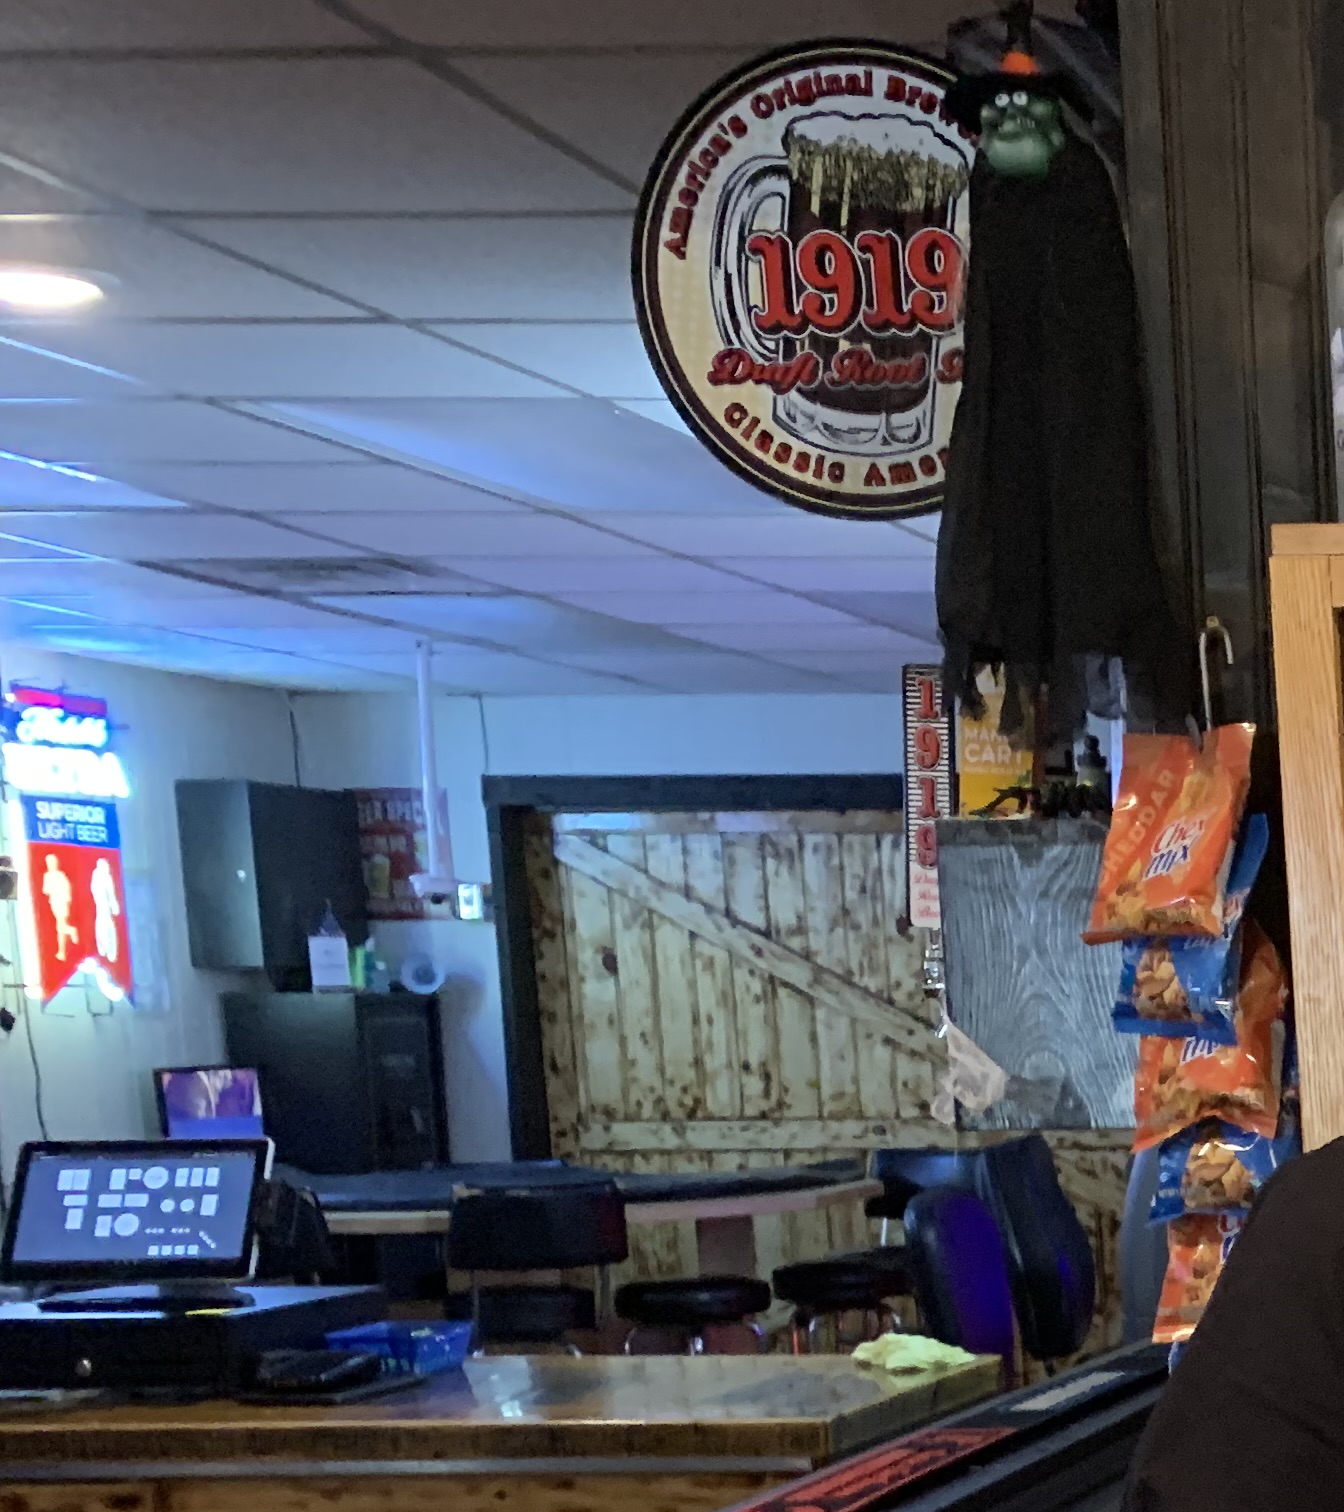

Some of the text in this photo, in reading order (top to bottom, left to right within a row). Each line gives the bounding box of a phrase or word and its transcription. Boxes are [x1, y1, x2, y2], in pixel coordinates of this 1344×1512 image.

[663, 66, 873, 260] America's Original
[746, 230, 965, 336] 1919
[723, 402, 948, 488] Classic Amer
[963, 743, 1023, 765] CART
[36, 801, 106, 825] SUPERIOR
[37, 821, 108, 844] LIGHT BEER
